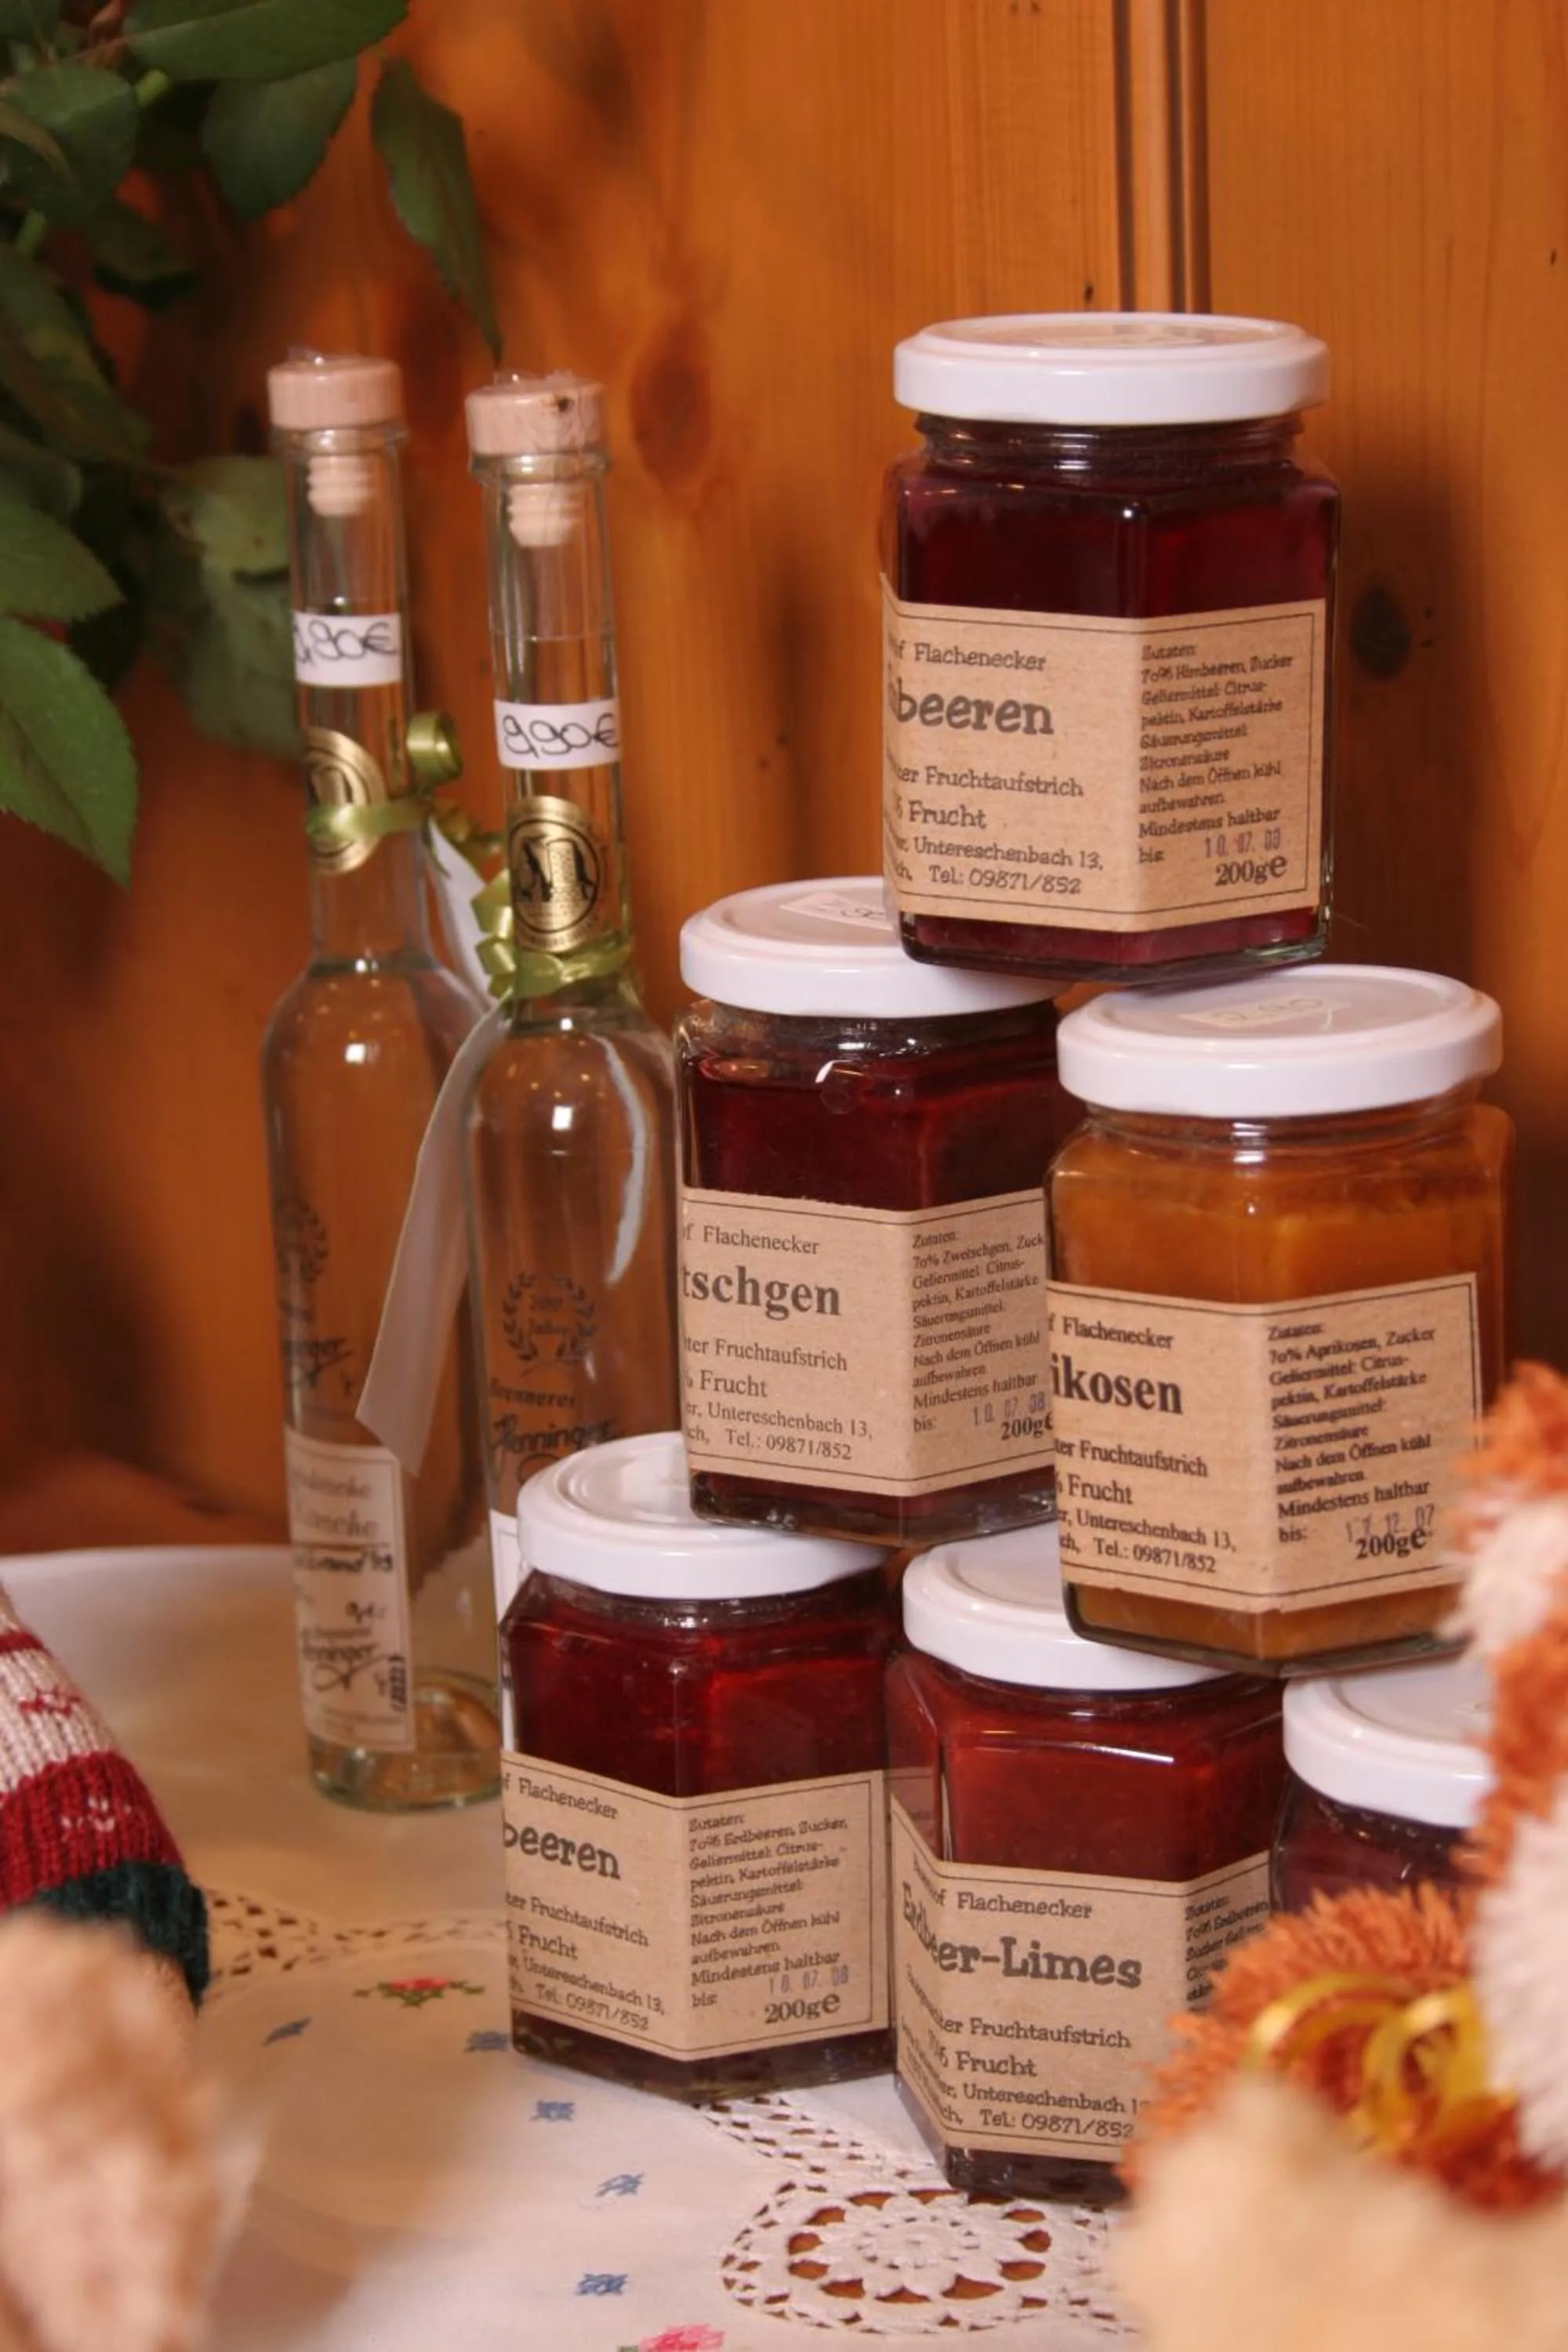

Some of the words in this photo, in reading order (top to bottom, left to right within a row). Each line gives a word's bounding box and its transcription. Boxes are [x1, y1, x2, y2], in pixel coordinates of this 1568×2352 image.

[914, 643, 1047, 672] Flachenecker
[926, 765, 1084, 797] Fruchtaufstrich
[1139, 775, 1174, 793] Nach
[1177, 771, 1204, 788] dem
[1207, 764, 1250, 785] Öffnen
[1254, 760, 1281, 778] kühl
[909, 800, 988, 829] Frucht
[1138, 815, 1223, 839] Mindestens
[1227, 807, 1281, 827] haltbar
[914, 836, 1073, 867] Untereschenbach
[968, 871, 1082, 895] 09871/852
[703, 1225, 820, 1255] Flachenecker
[955, 1274, 1040, 1301] Kartoffelstärke
[1063, 1316, 1174, 1349] Flachenecker
[1385, 1328, 1436, 1347] Zucker
[715, 1338, 848, 1372] Fruchtaufstrich
[912, 1348, 943, 1368] Nach
[946, 1342, 971, 1360] dem
[974, 1336, 1014, 1357] Öffnen
[1015, 1330, 1041, 1350] kühl
[700, 1370, 768, 1398] Frucht
[913, 1382, 989, 1410] Mindestens
[992, 1372, 1038, 1394] haltbar
[1051, 1352, 1184, 1415] ikosen
[707, 1401, 843, 1435] Untereschenbach
[765, 1433, 851, 1461] 09871/852
[1080, 1440, 1208, 1477] Fruchtaufstrich
[1275, 1453, 1312, 1474] Nach
[1316, 1447, 1346, 1465] dem
[1348, 1441, 1397, 1461] Öffnen
[1399, 1433, 1432, 1452] kühl
[1067, 1473, 1134, 1504] Frucht
[1278, 1490, 1370, 1519] Mindestens
[1374, 1480, 1430, 1503] haltbar
[1076, 1509, 1207, 1545] Untereschenbach
[1279, 1526, 1307, 1544] bis:
[1133, 1544, 1216, 1574] 09871/852
[519, 1777, 618, 1820] Flachenecker
[738, 1855, 840, 1882] Kartoffelstärke
[957, 1891, 1093, 1919] Flachenecker
[531, 1896, 650, 1948] Fruchtaufstrich
[690, 1927, 728, 1947] Nach
[729, 1922, 759, 1939] dem
[761, 1915, 808, 1936] Öffnen
[810, 1911, 840, 1928] kühl
[518, 1924, 578, 1960] Frucht
[523, 1954, 644, 2007] Untereschenbach
[691, 1959, 781, 1987] Mindestens
[784, 1951, 841, 1971] haltbar
[566, 1992, 649, 2031] 09871/852
[970, 2017, 1132, 2049] Fruchtaufstrich
[956, 2051, 1038, 2078] Frucht
[963, 2083, 1125, 2114] Untereschenbach
[1022, 2112, 1134, 2139] 09871/852
